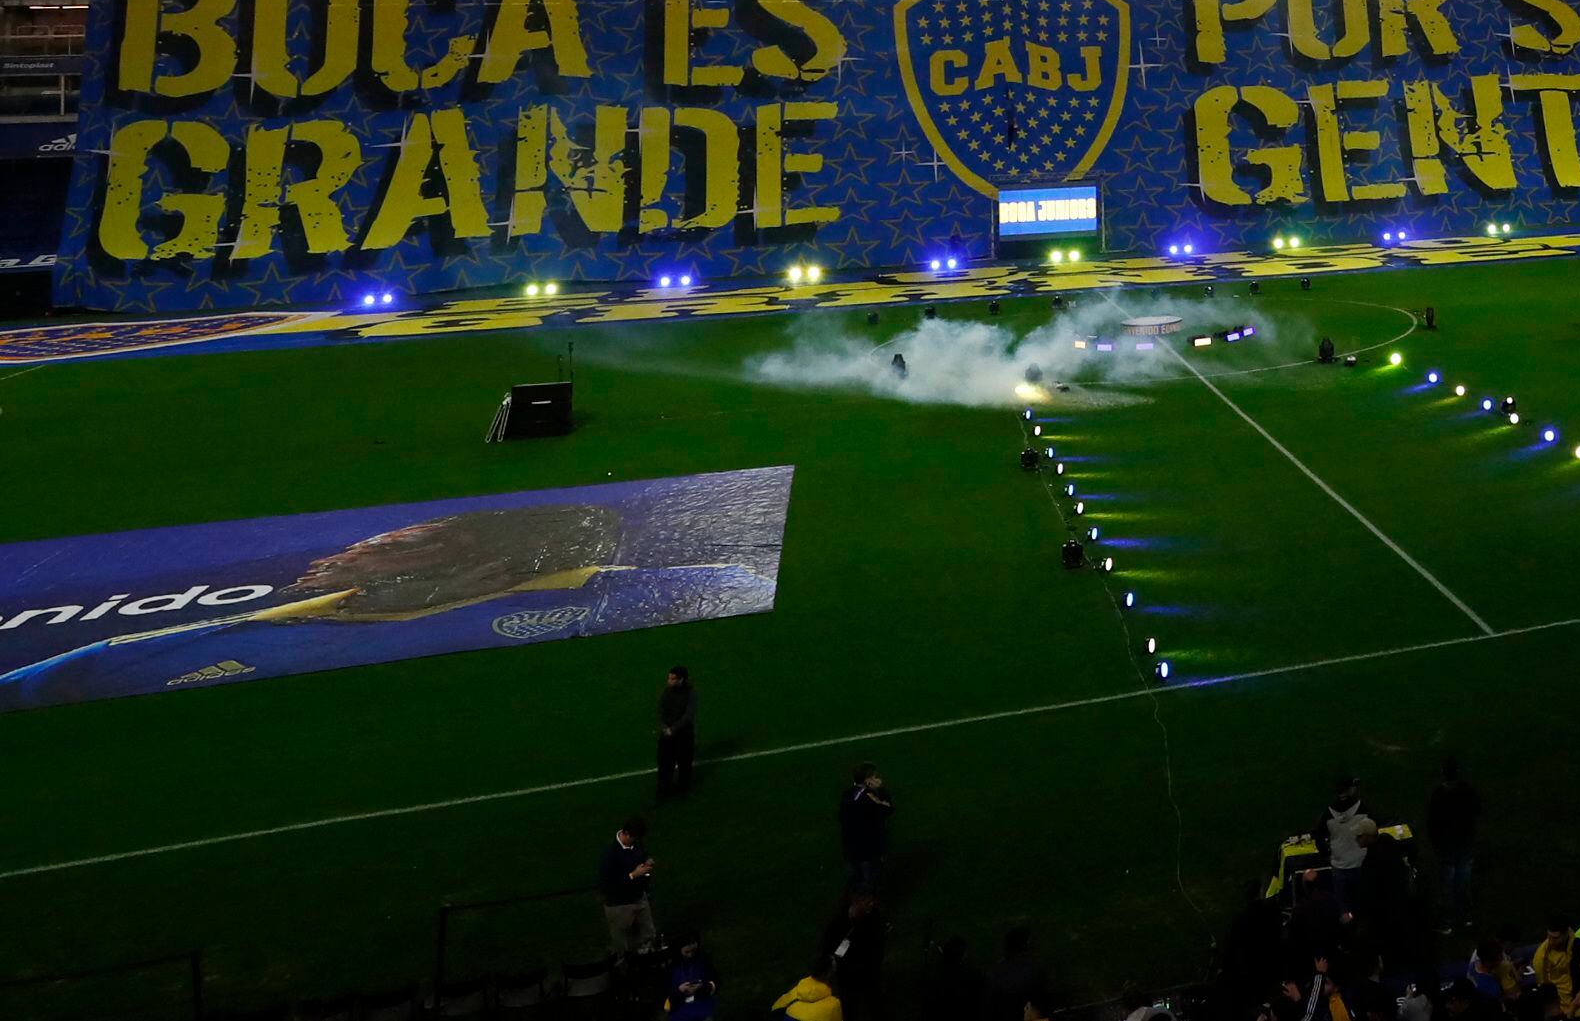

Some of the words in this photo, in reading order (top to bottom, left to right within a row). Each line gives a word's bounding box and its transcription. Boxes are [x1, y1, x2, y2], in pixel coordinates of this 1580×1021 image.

[929, 39, 1102, 96] CABJ
[98, 101, 841, 261] GRANDE
[0, 584, 274, 630] nido
[167, 666, 256, 686] adidas
